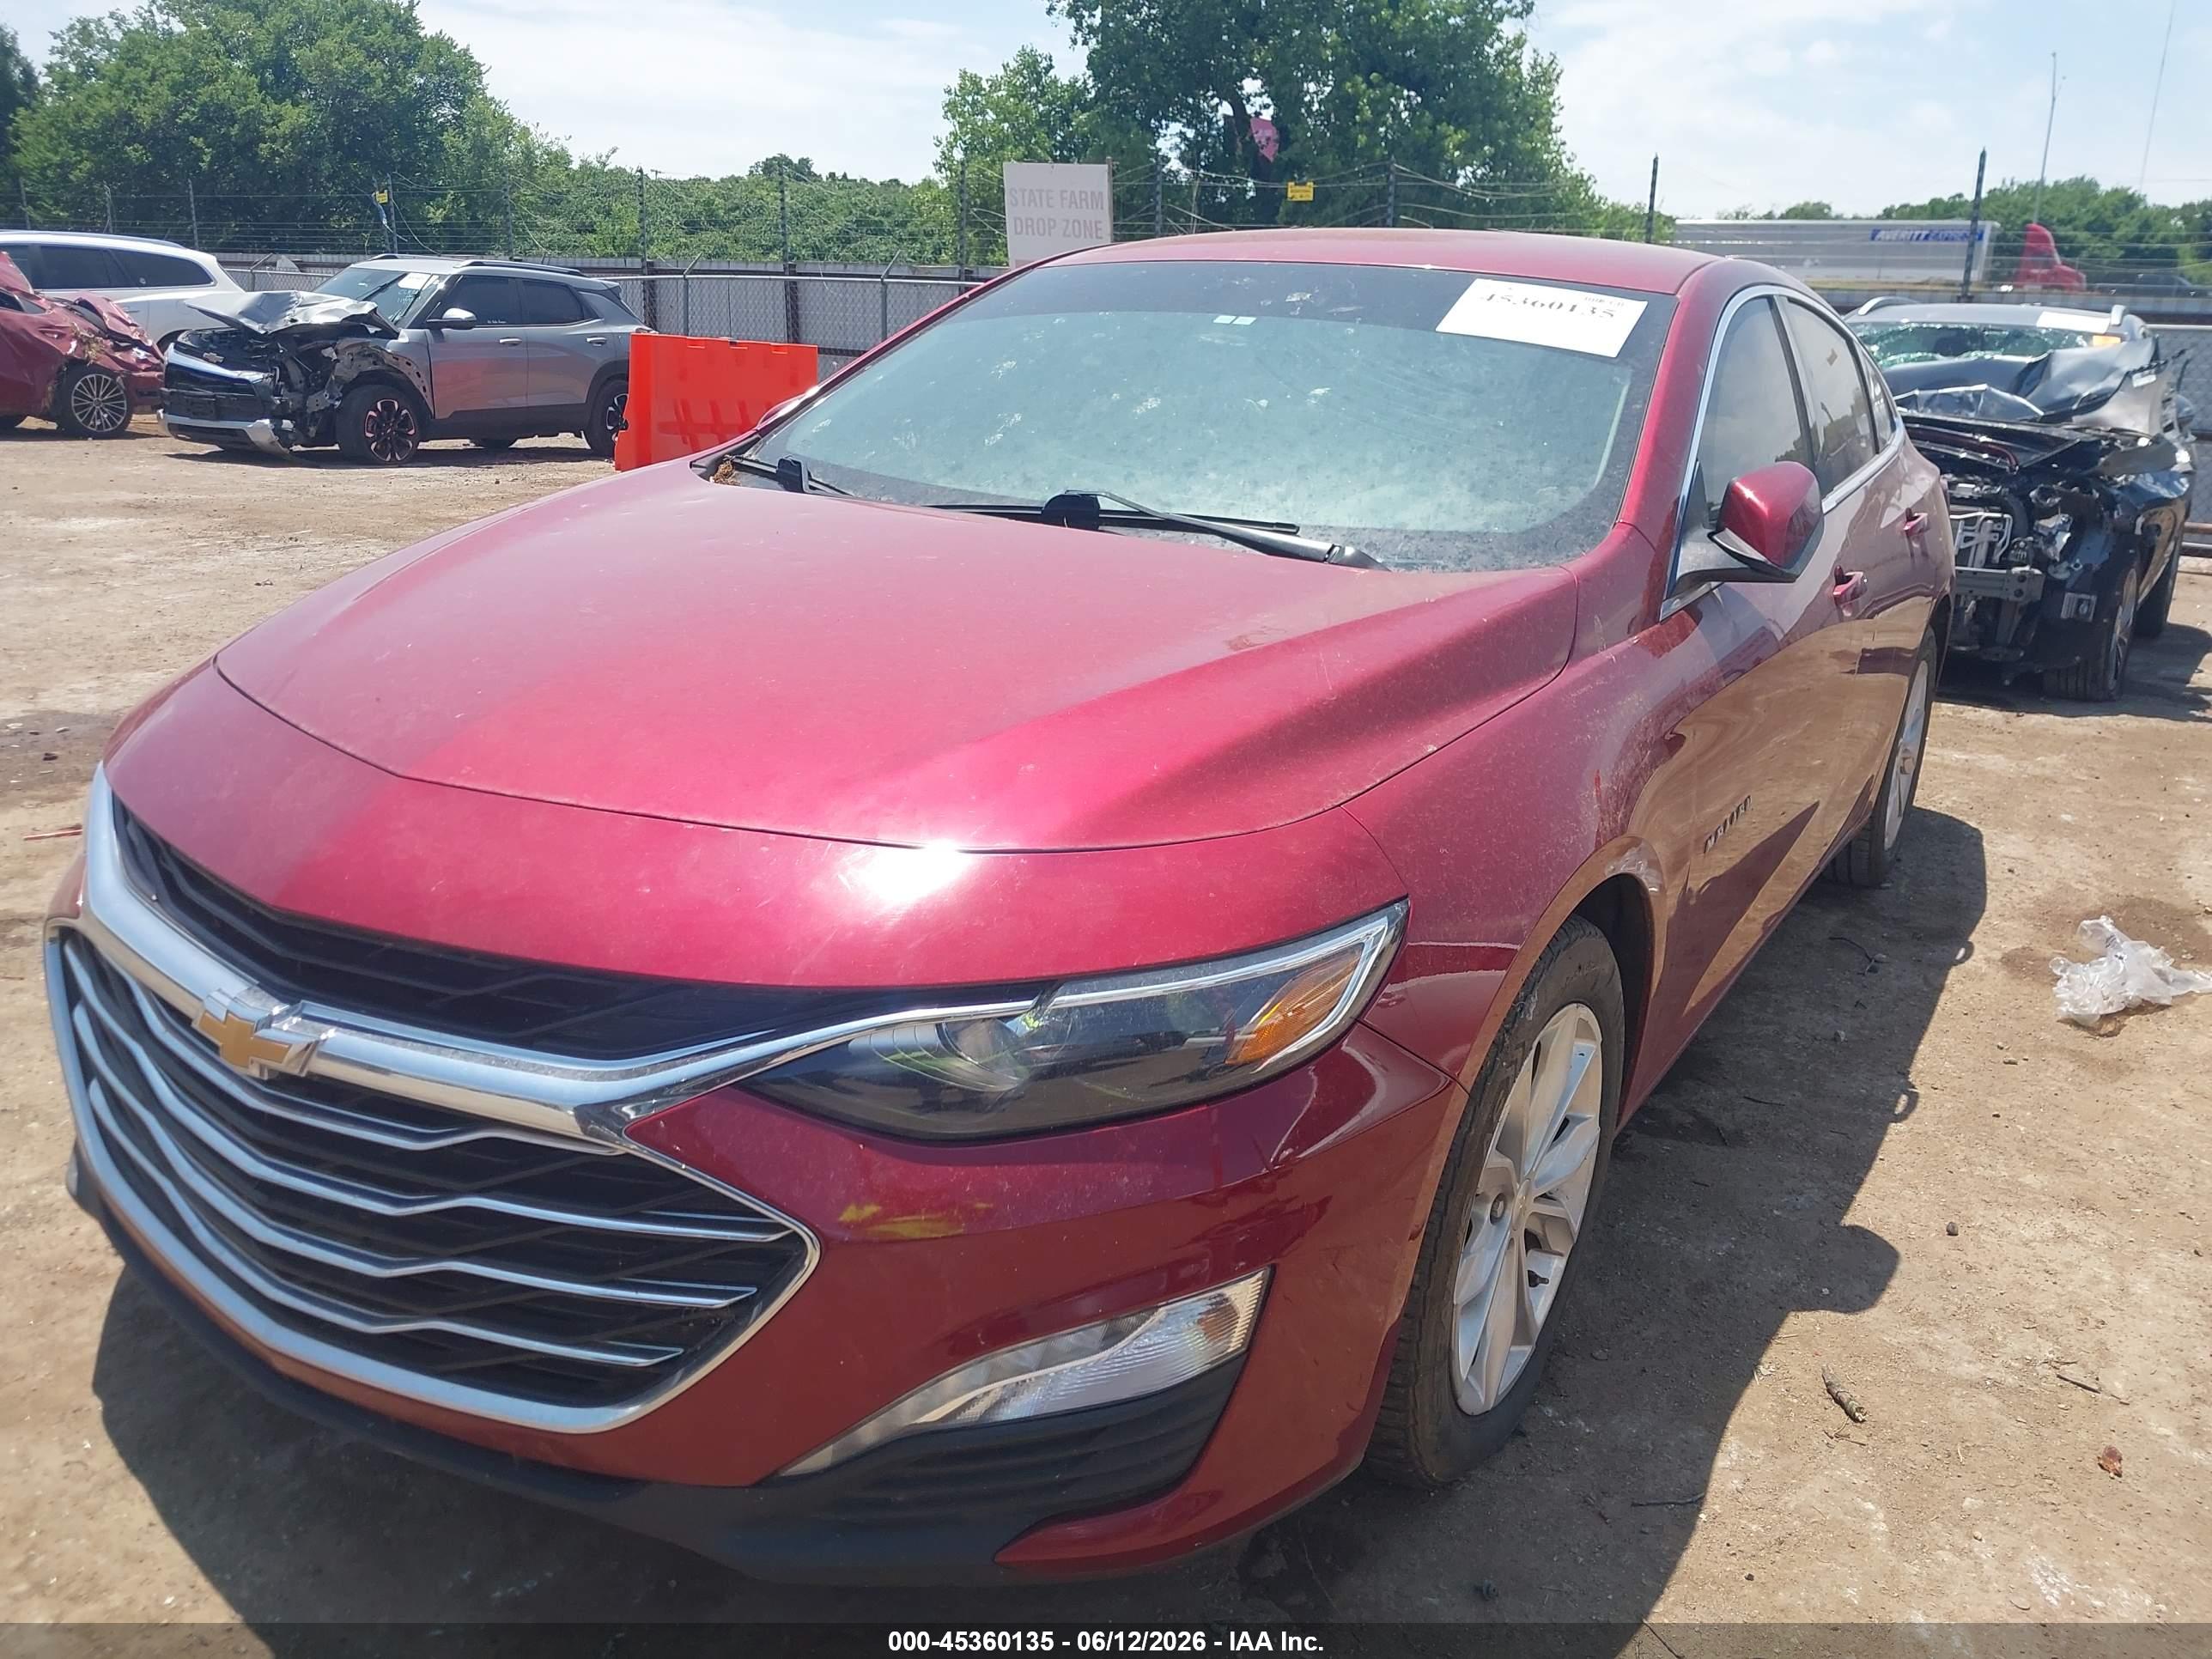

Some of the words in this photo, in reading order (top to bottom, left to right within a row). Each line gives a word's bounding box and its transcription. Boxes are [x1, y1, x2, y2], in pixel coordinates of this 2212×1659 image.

[1009, 187, 1054, 209] STATE
[1059, 189, 1105, 210] FARM
[1013, 216, 1057, 237] DROP
[1061, 218, 1104, 240] ZONE
